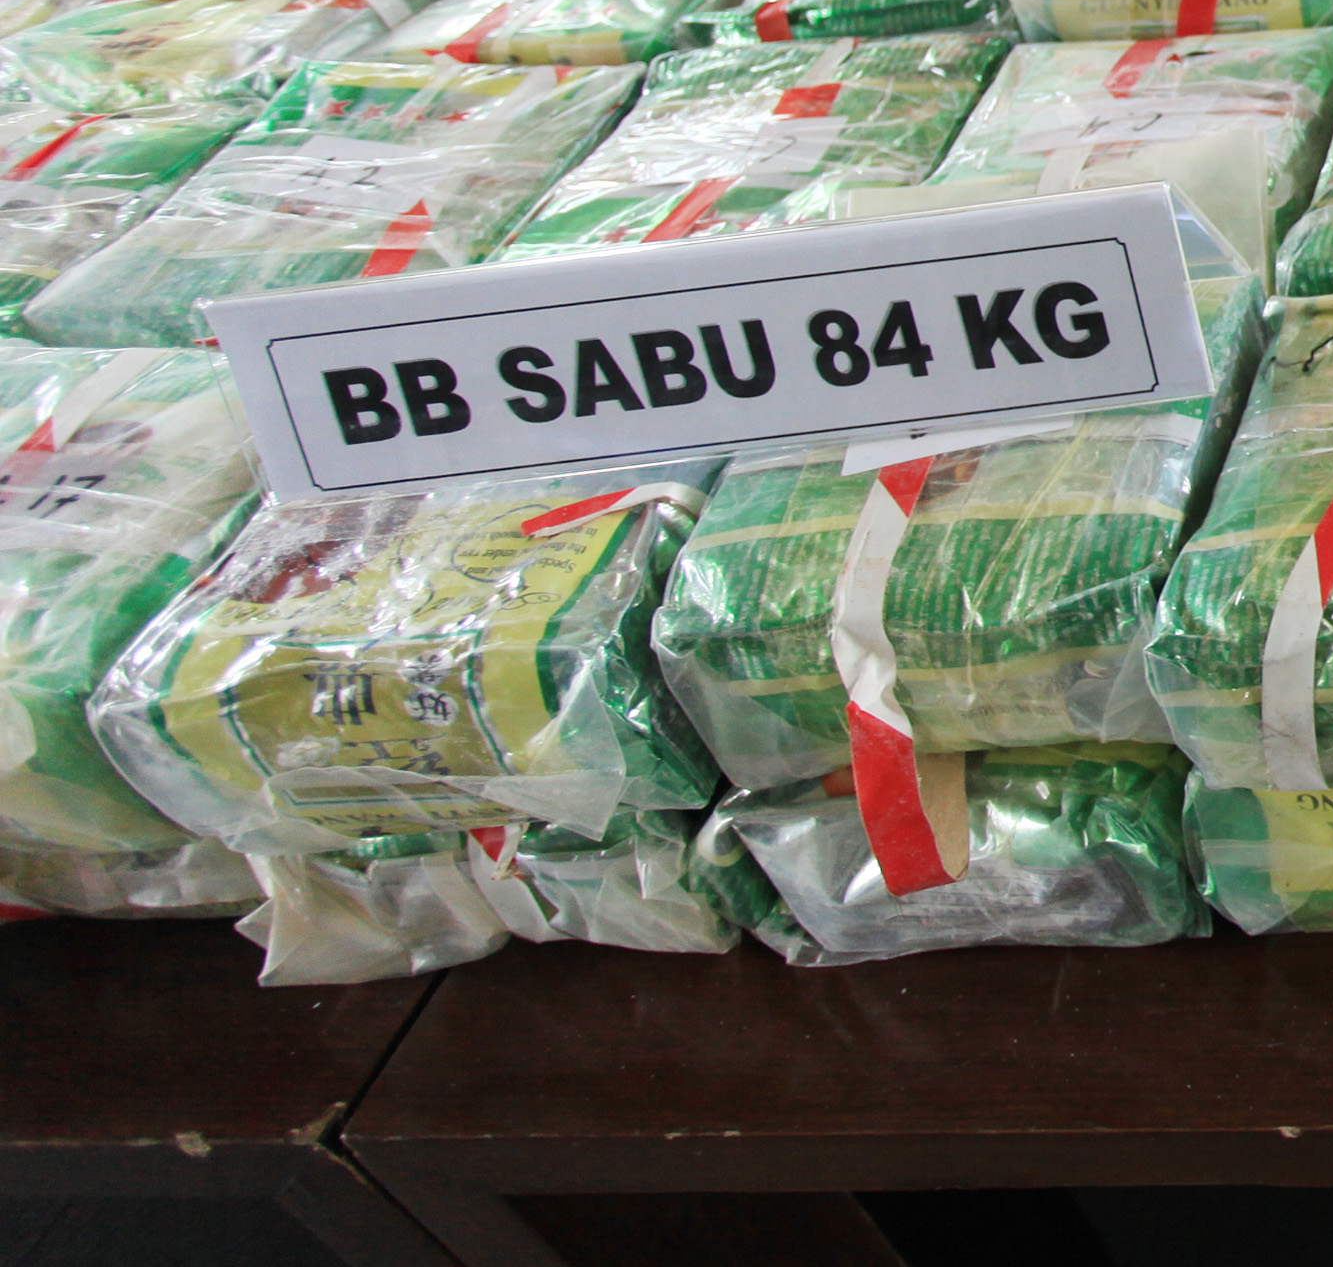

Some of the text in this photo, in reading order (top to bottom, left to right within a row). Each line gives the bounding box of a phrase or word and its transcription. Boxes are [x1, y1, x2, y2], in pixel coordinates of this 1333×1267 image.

[321, 280, 1112, 446] BB SABU 84 KG
